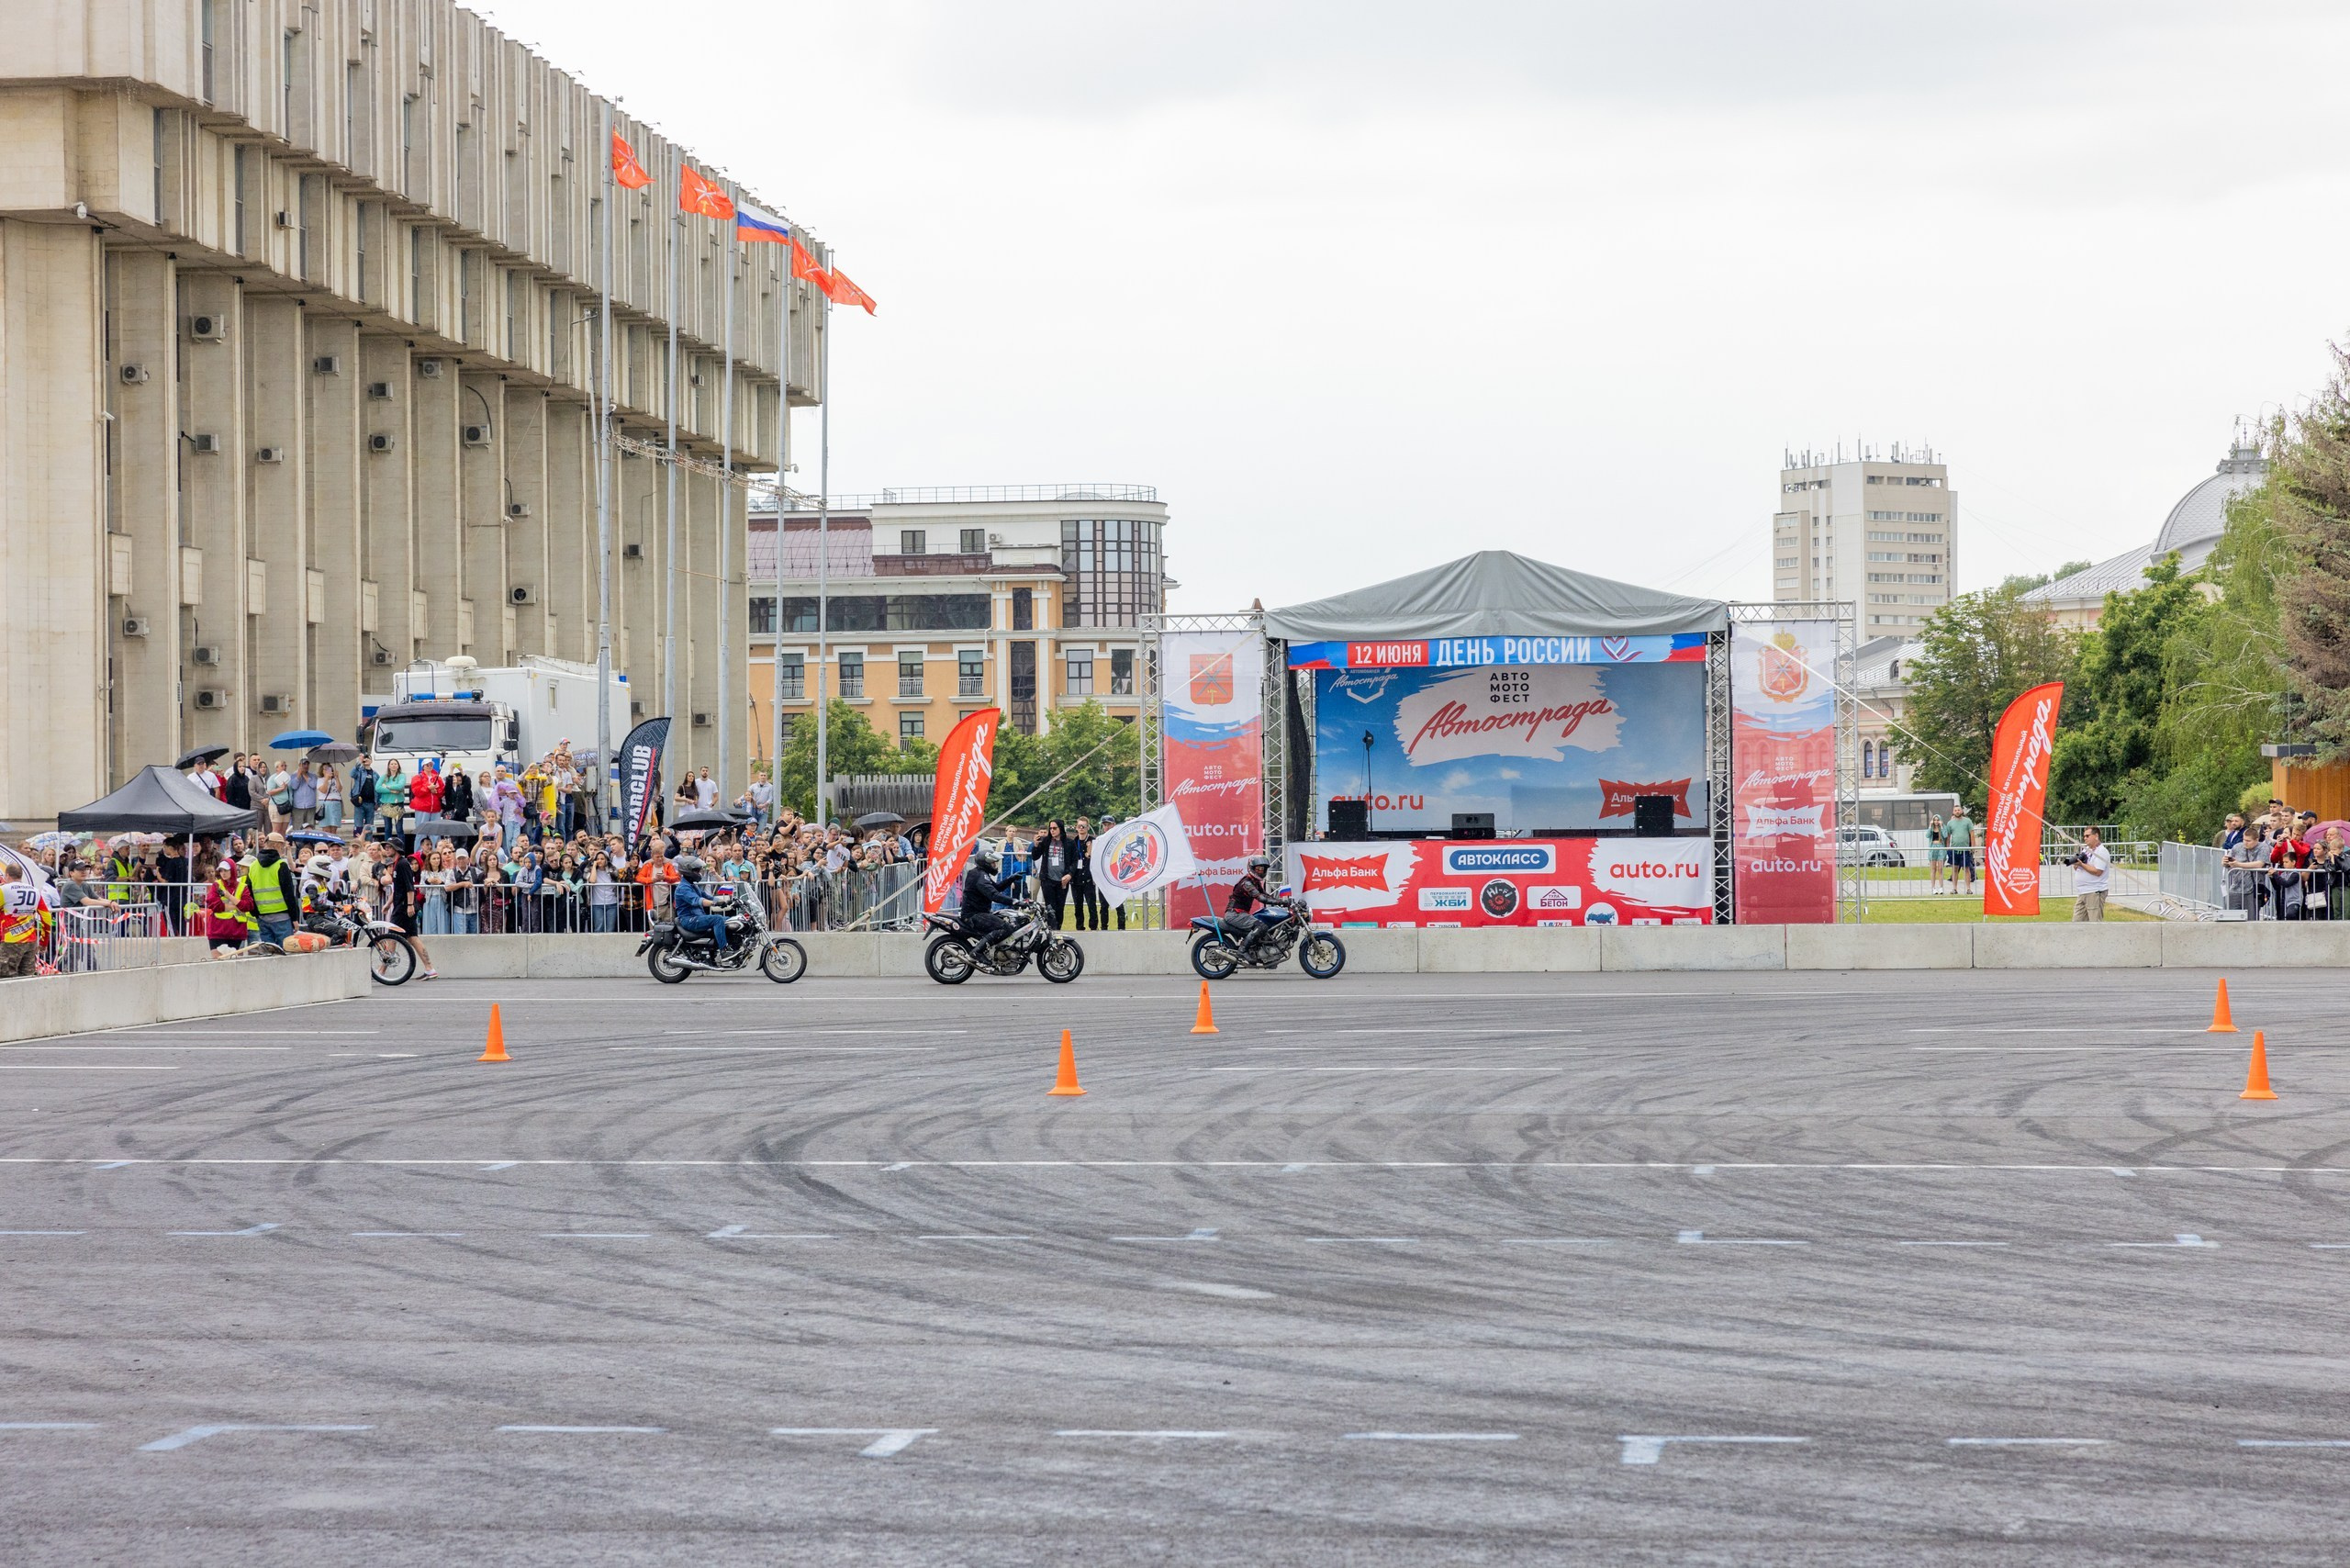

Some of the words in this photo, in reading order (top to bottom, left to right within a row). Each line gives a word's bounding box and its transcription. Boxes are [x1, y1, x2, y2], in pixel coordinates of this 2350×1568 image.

[1355, 645, 1372, 664] 12
[1376, 644, 1422, 664] ИЮНЯ
[1436, 639, 1494, 666] ДЕНЬ
[1504, 637, 1591, 664] РОССИИ
[1328, 673, 1399, 693] Автострада
[1490, 672, 1529, 681] АВТО
[1490, 683, 1529, 692] МОТО
[1490, 694, 1529, 703] ФЕСТ
[1408, 698, 1612, 755] Автострада
[2003, 730, 2028, 791] АВТОМОБИЛЬНЫЙ
[1169, 777, 1259, 801] Автострада
[1738, 768, 1831, 794] Автострада
[934, 814, 950, 851] ОТКРЫТЫЙ
[946, 753, 967, 813] АВТОМОБИЛЬНЫЙ
[1756, 816, 1788, 826] Альфа
[1790, 816, 1815, 824] Банк
[1998, 792, 2014, 834] ФЕСТИВАЛЬ
[938, 813, 957, 853] ФЕСТИВАЛЬ
[1458, 853, 1540, 866] АВТОКЛАСС
[1751, 859, 1821, 872] auto.ru
[1220, 867, 1244, 875] Банк
[1312, 867, 1348, 879] Альфа
[1349, 867, 1378, 877] Банк
[1609, 861, 1699, 879] auto.ru
[13, 890, 37, 906] 30
[1435, 899, 1467, 907] ЖБИ
